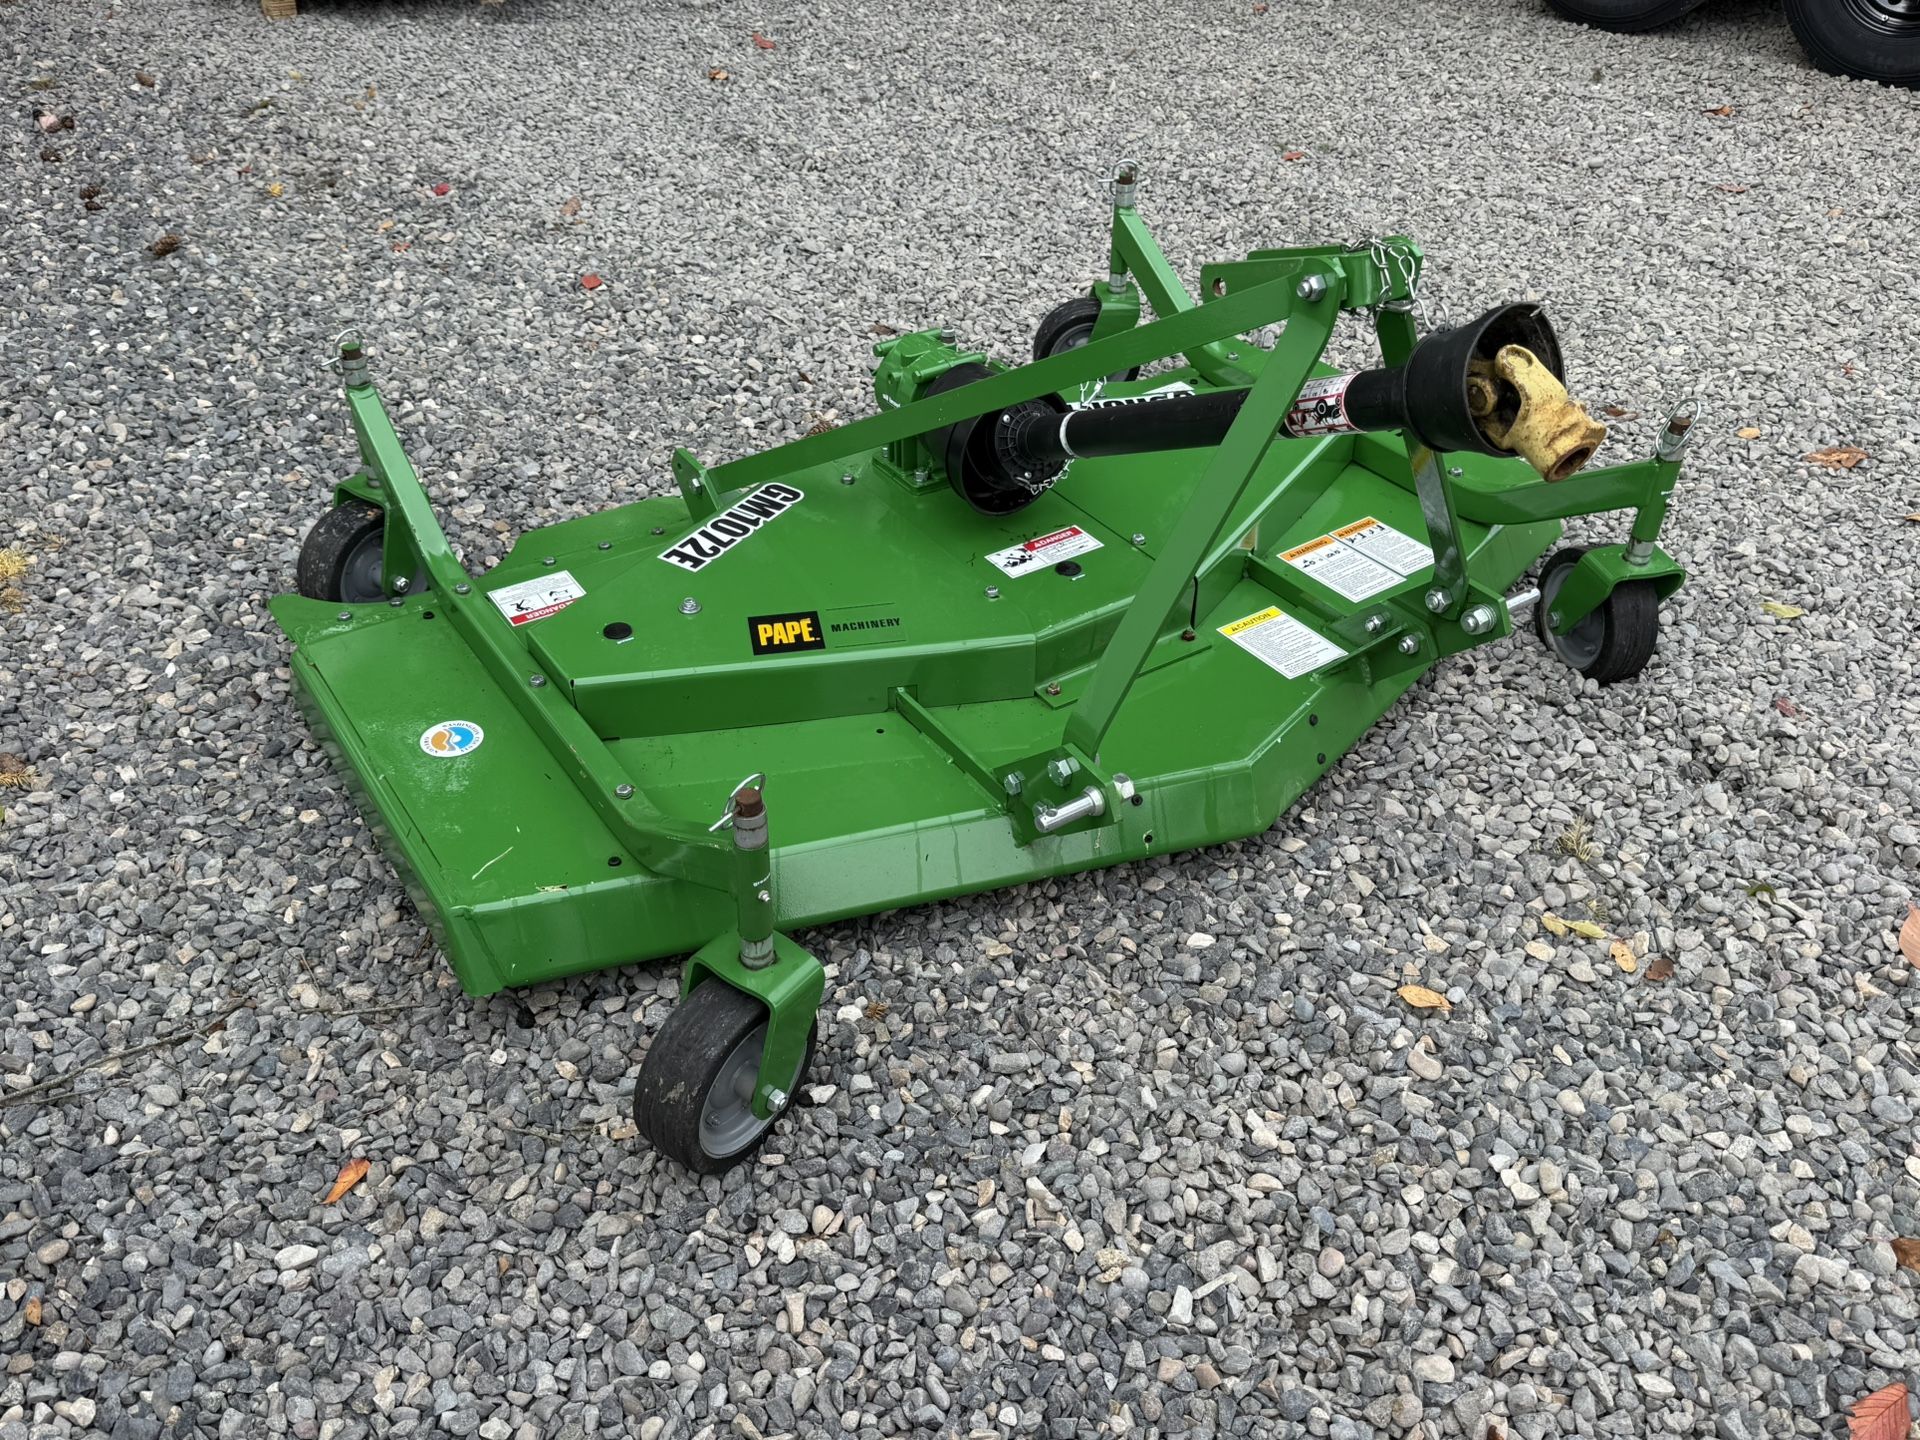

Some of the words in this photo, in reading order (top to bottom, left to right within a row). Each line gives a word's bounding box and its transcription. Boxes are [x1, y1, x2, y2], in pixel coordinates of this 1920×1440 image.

[664, 483, 801, 569] GM1072E
[1344, 520, 1375, 535] WARNING
[1040, 531, 1073, 546] DANGER
[1296, 540, 1327, 555] WARNING
[525, 603, 566, 619] DANGER
[1237, 612, 1271, 629] CAUTION
[758, 618, 815, 646] PAPE
[831, 618, 901, 633] MACHINERY
